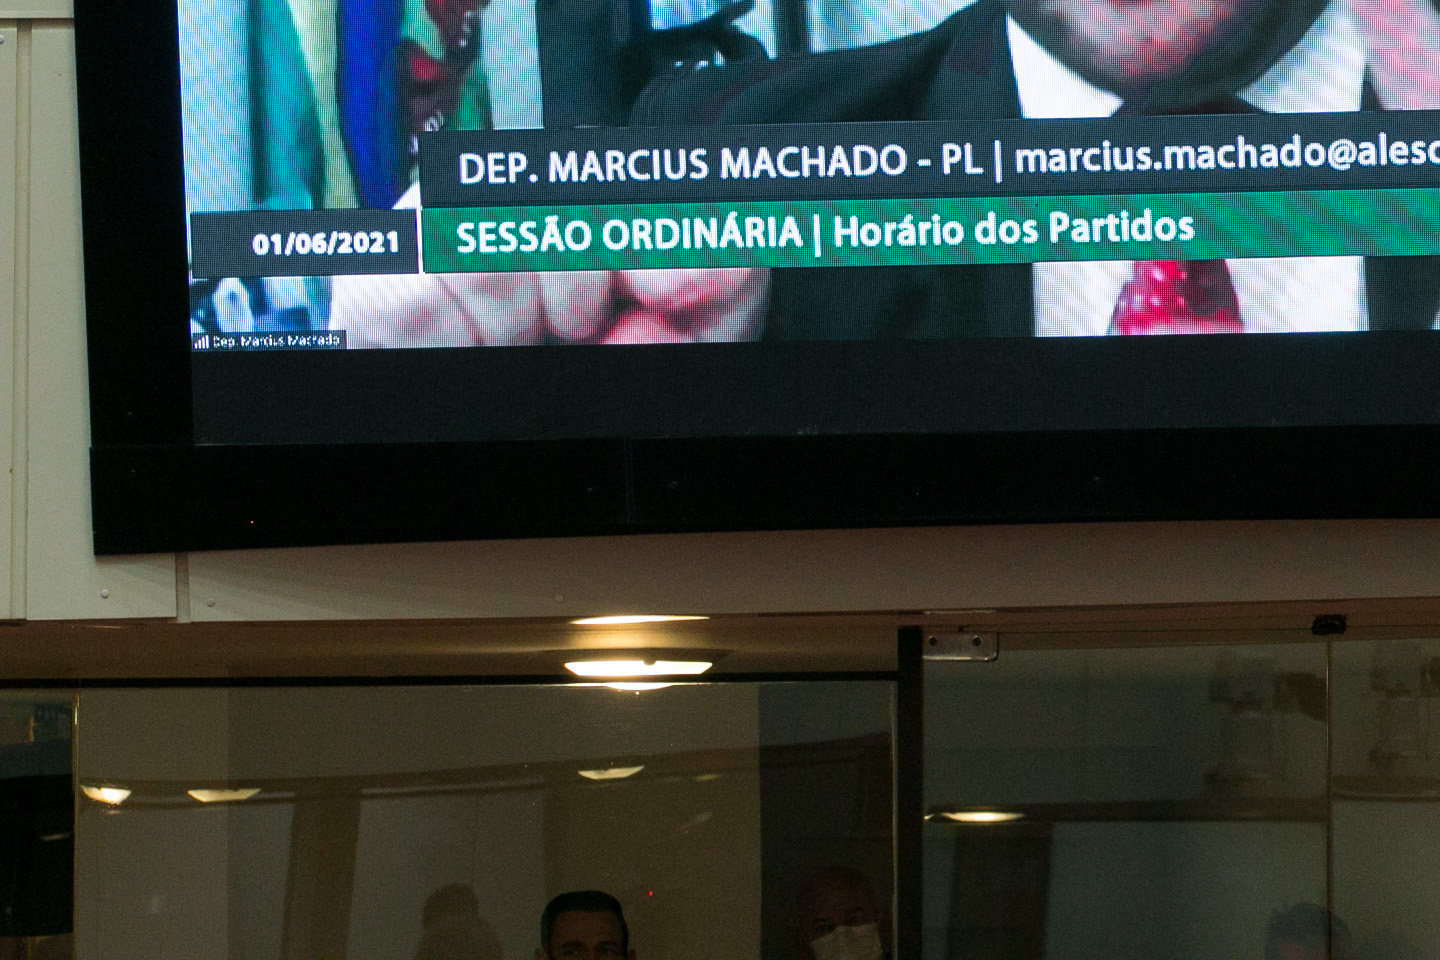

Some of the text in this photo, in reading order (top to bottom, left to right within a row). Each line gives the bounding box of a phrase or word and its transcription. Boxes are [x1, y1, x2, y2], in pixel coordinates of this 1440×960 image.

[459, 152, 538, 184] DEP.
[548, 148, 709, 182] MARCIUS
[720, 144, 908, 180] MACHADO
[941, 142, 984, 175] PL
[252, 231, 399, 255] 01/06/2021
[456, 216, 592, 254] SESSÃO
[602, 211, 803, 251] ORDINÁRIA
[834, 213, 965, 247] Horário
[974, 211, 1039, 244] dos
[1050, 208, 1196, 243] Partidos
